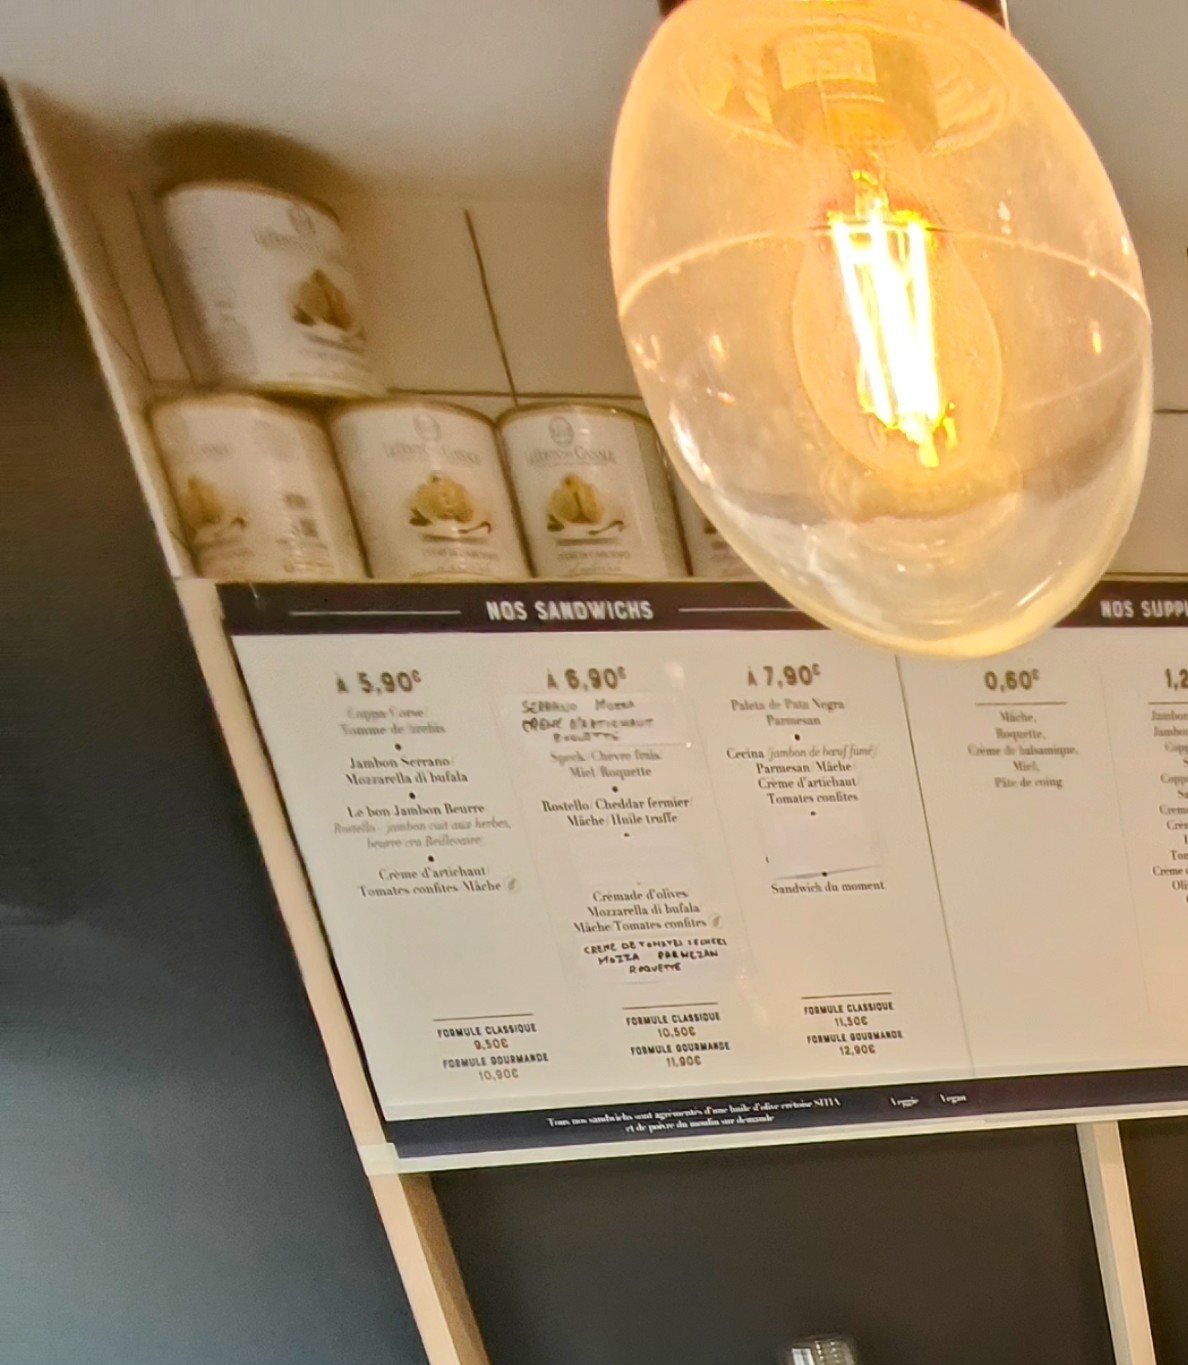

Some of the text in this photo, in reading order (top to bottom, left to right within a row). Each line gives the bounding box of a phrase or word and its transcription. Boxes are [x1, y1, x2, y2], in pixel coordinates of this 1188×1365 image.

[486, 600, 654, 621] NOS SANDWICHS
[1101, 600, 1134, 618] NOS
[766, 714, 821, 726] Parmesan
[350, 756, 449, 770] Jambon Serrano
[756, 761, 852, 774] Parmesan Mâche
[346, 772, 468, 787] Mozzarella di bufala
[758, 776, 856, 789] Crème d'artichaut
[595, 799, 645, 811] Cheddar
[647, 797, 690, 809] fermier
[767, 791, 859, 805] Tomates confites
[348, 803, 485, 818] Le bon Jambon Beurre
[568, 812, 678, 827] Mâche Huile truffe
[379, 866, 486, 881] Crème d'artichaut
[359, 880, 501, 898] Tomates confites Mâche
[771, 880, 885, 894] Sandwich du moment
[587, 903, 700, 918] Mozzarella di bufala
[574, 918, 707, 934] Mâche Tomates confites
[622, 941, 636, 950] DE
[804, 1001, 894, 1015] FORMULE CLASSIQUE
[626, 1012, 721, 1026] FORMULE CLASSIQUE
[437, 1023, 537, 1038] FORMULE CLASSIQUE
[807, 1030, 903, 1045] FORMULE GOURMANDE
[630, 1041, 731, 1057] FORMULE GOURMANDE
[443, 1053, 549, 1070] FORMULE GOURMANDE
